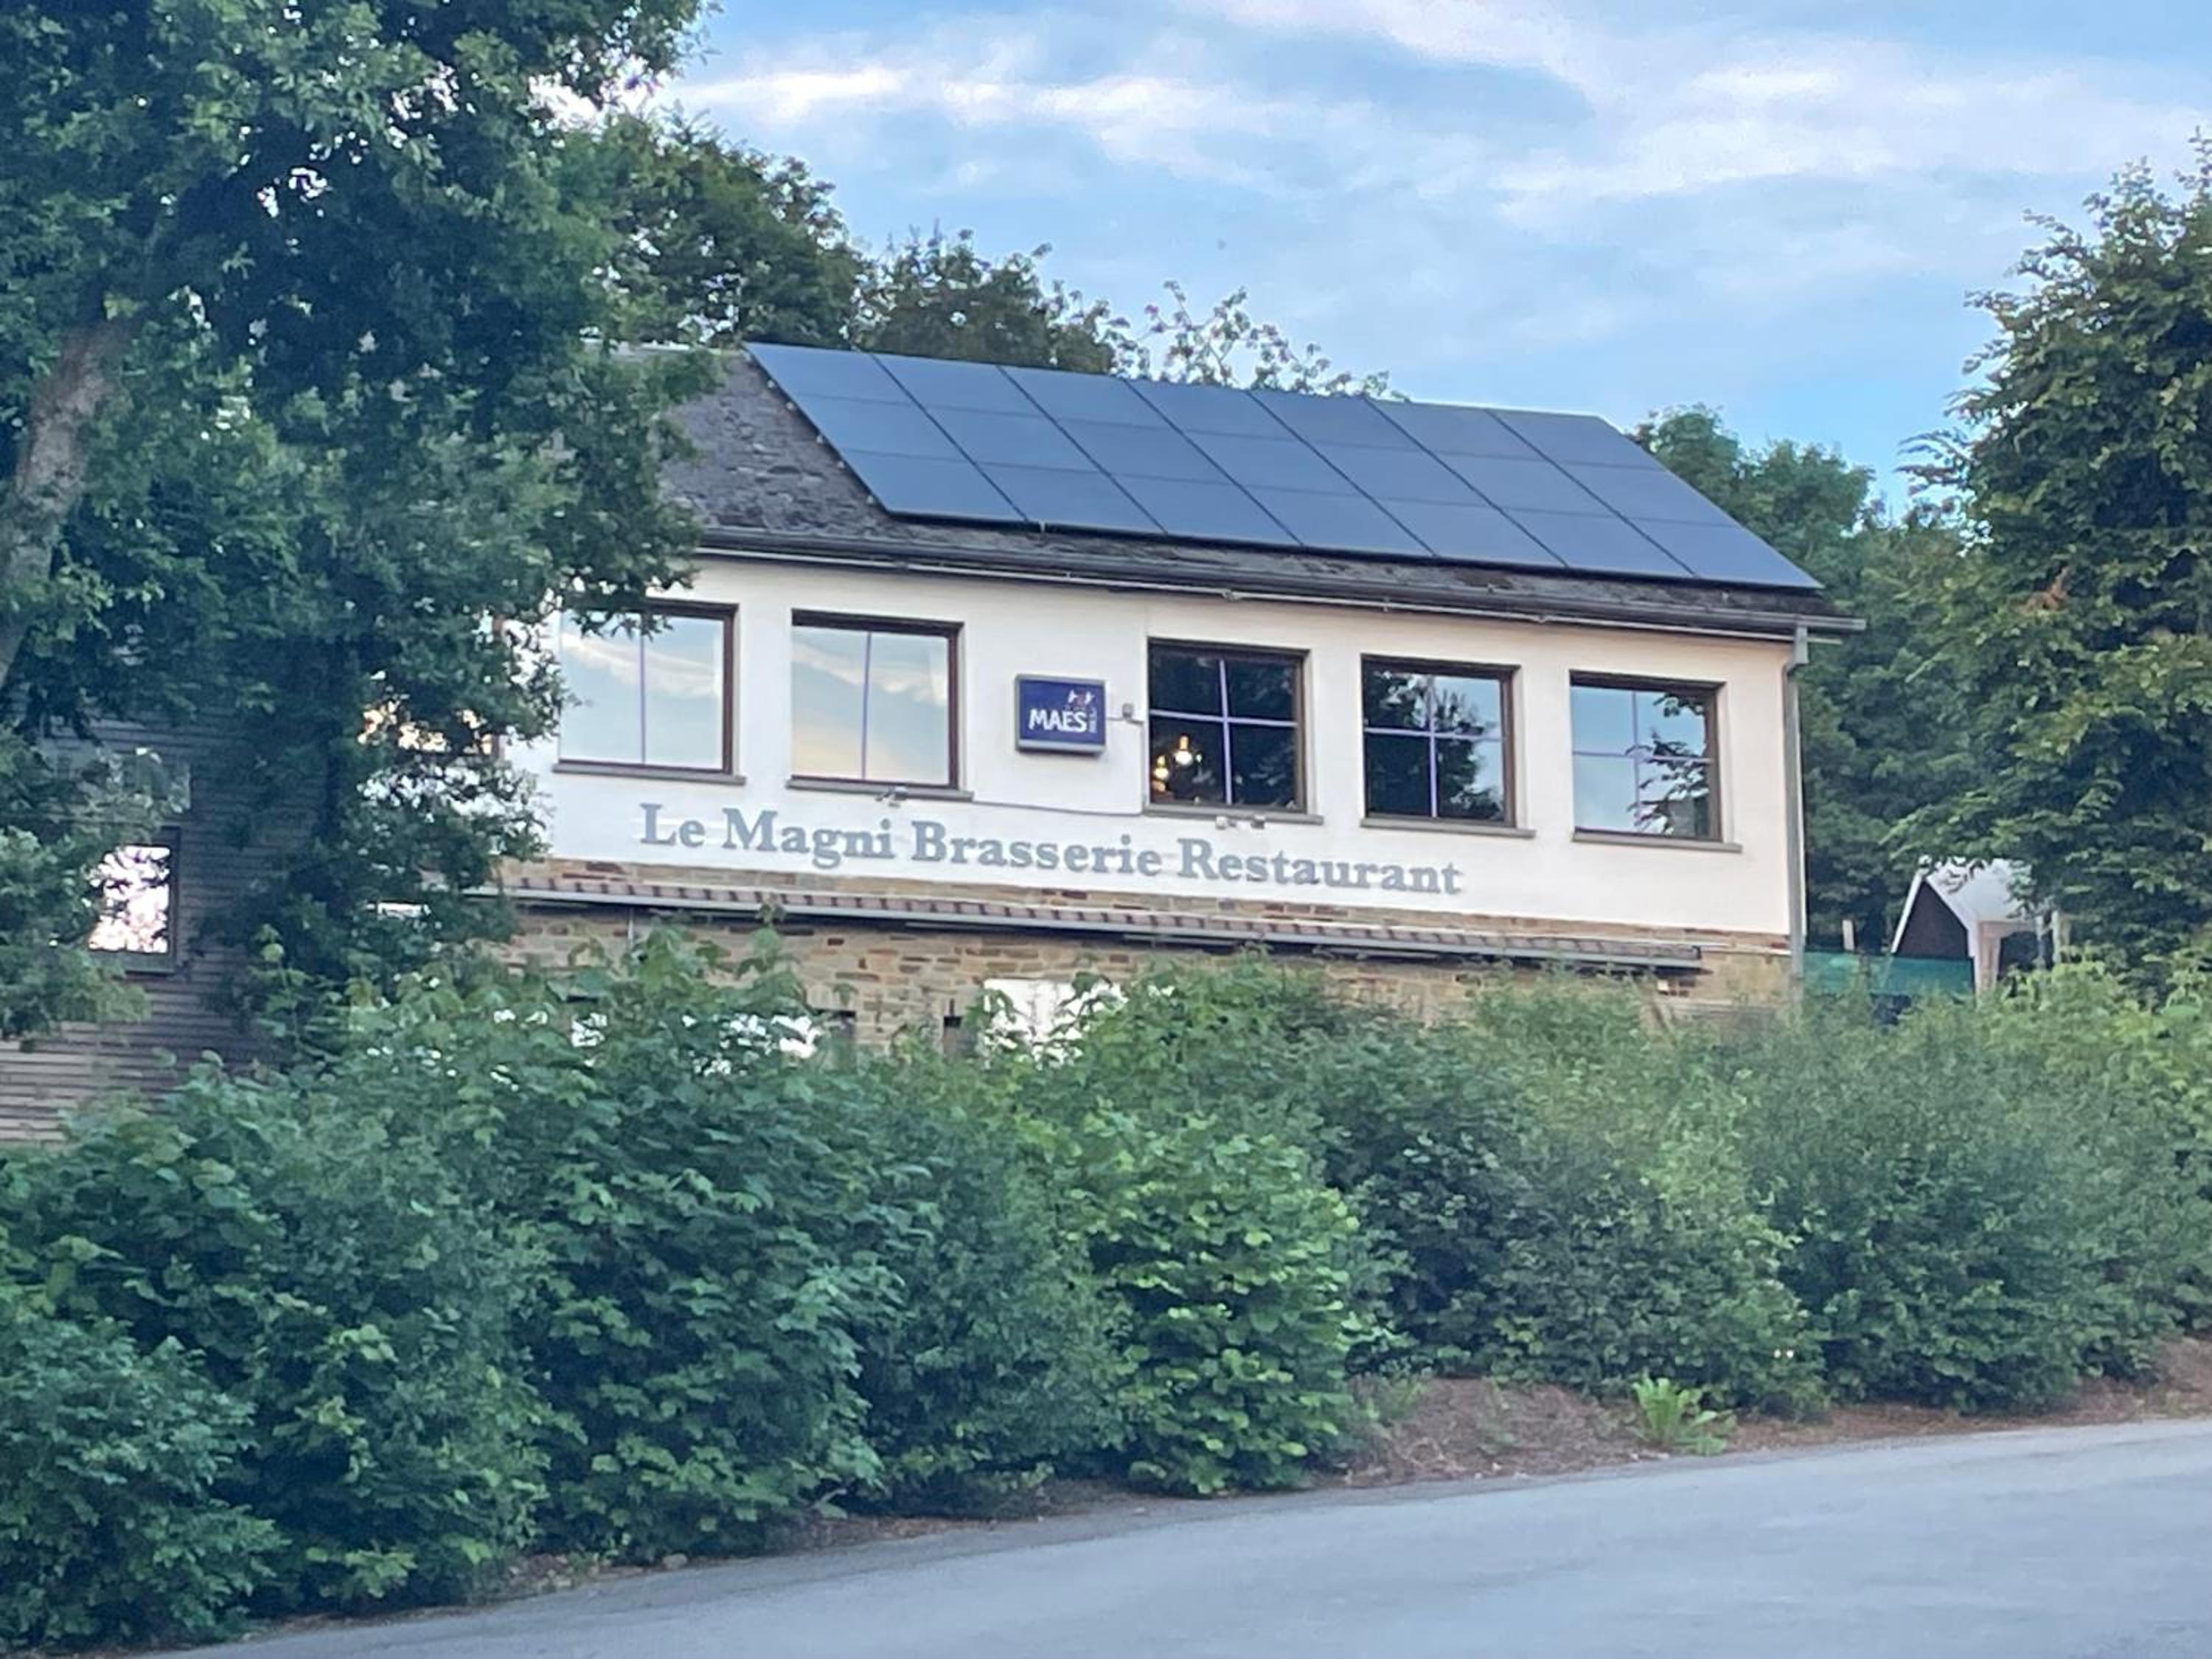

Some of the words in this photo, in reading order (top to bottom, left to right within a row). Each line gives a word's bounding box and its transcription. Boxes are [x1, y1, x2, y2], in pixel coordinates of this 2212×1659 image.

[1029, 709, 1087, 732] MAES
[639, 803, 705, 848] Le
[721, 807, 896, 869] Magni
[911, 820, 1162, 877] Brasserie
[1177, 837, 1464, 895] Restaurant
